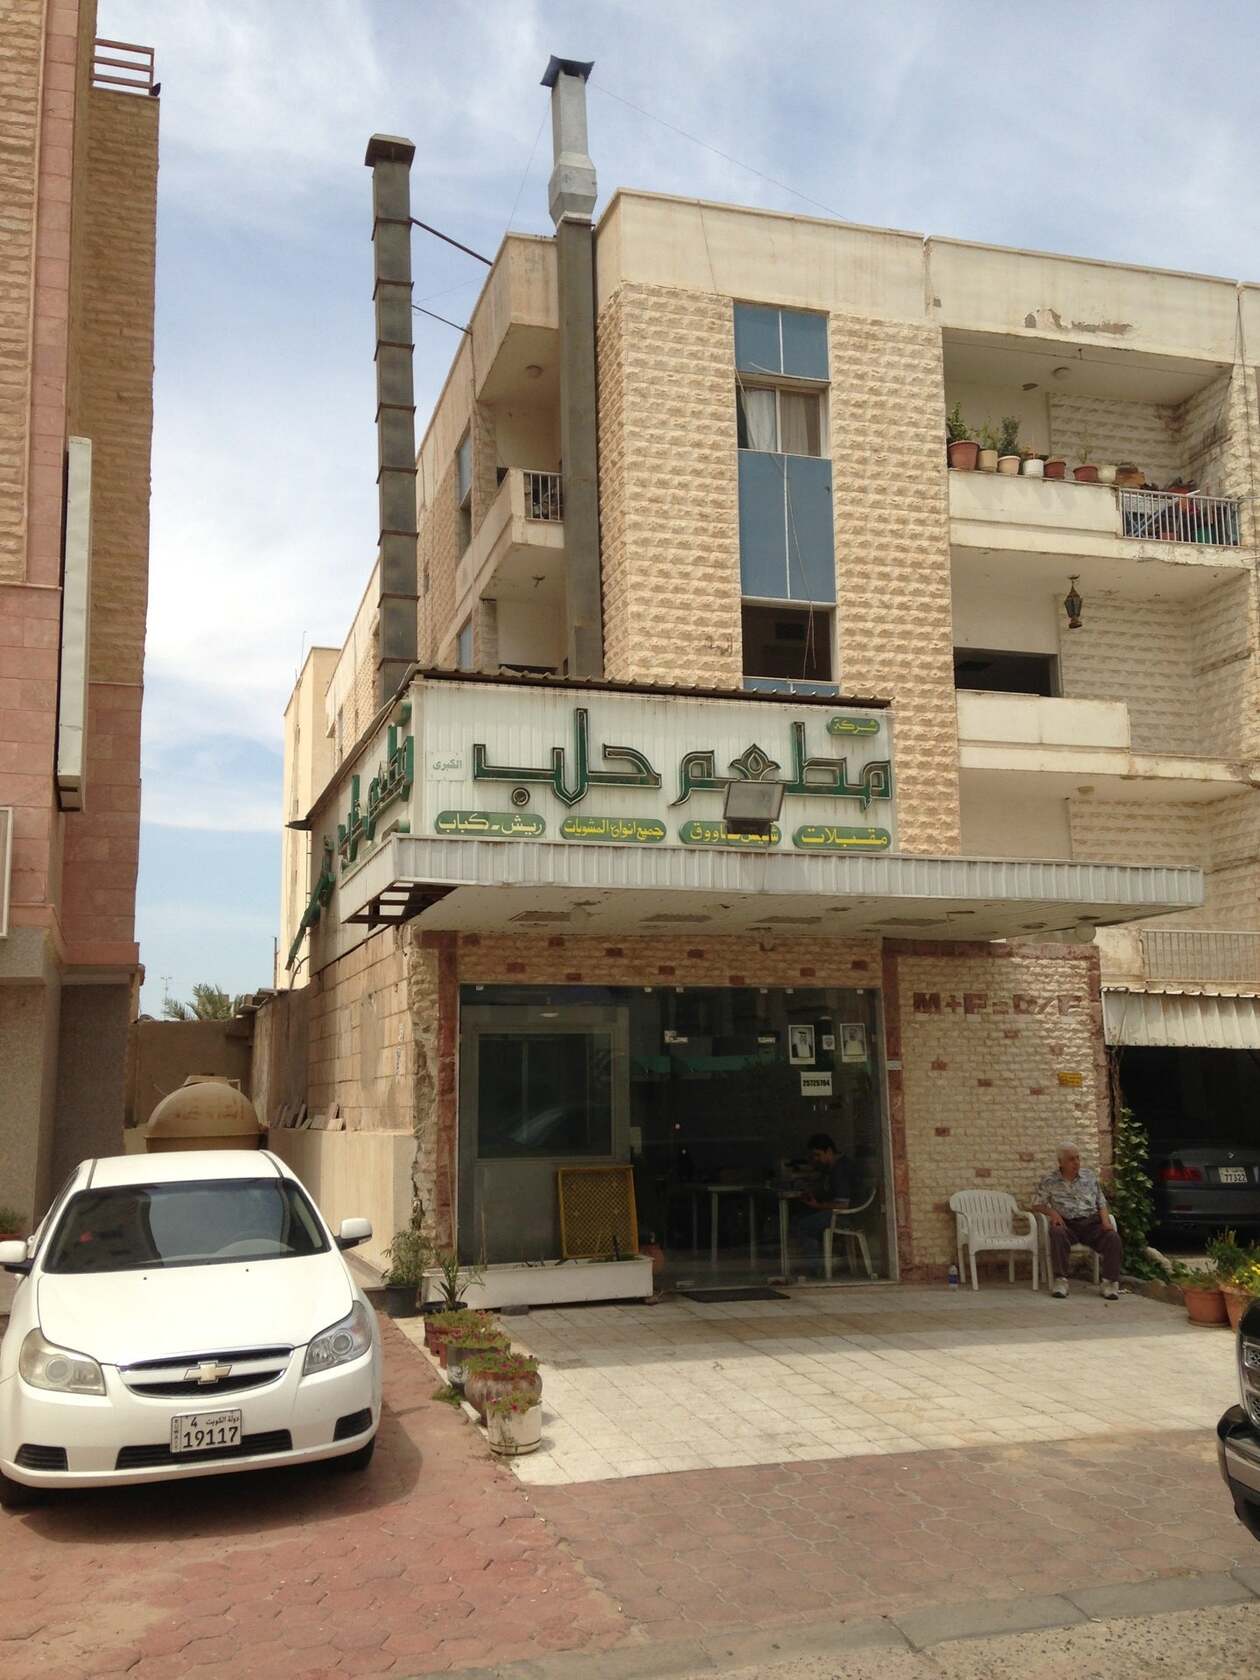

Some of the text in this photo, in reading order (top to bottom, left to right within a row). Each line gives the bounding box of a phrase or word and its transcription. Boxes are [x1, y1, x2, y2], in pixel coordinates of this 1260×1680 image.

[832, 718, 877, 735] شركة
[472, 708, 892, 809] مطعم حلب
[438, 812, 489, 833] كباب
[563, 818, 664, 840] جميع انواع المشويات
[801, 827, 888, 848] مقبلات
[190, 1416, 198, 1428] 4
[183, 1425, 239, 1448] 19117
